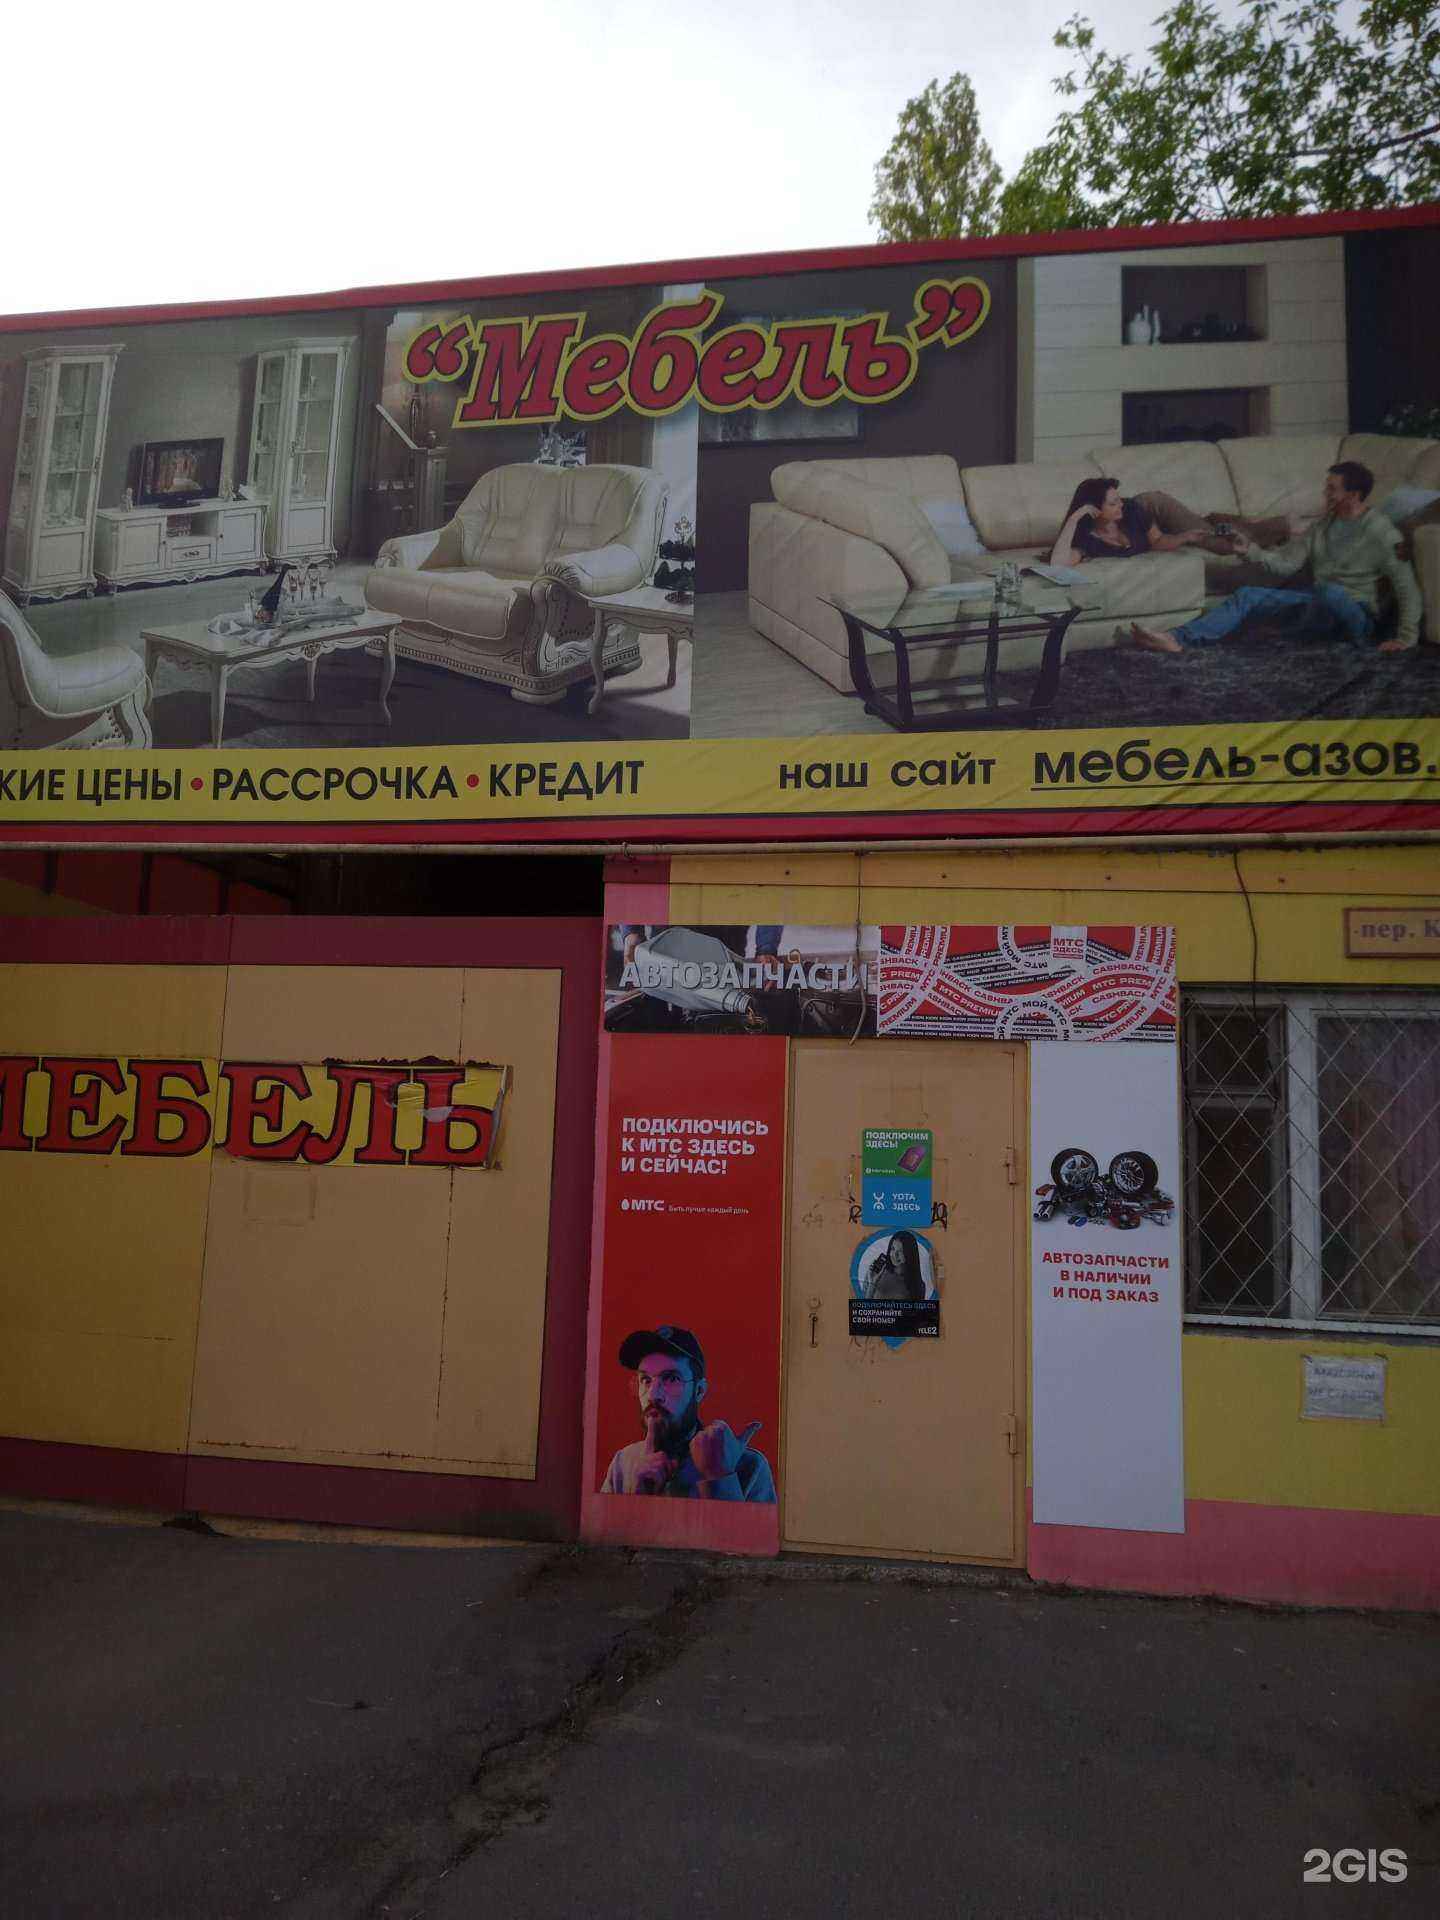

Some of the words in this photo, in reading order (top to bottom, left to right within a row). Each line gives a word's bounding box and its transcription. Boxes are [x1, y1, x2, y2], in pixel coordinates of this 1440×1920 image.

[778, 759, 869, 790] наш
[890, 751, 997, 788] сайт
[76, 768, 182, 806] ЦЕНЫ
[212, 764, 459, 802] РАССРОЧКА
[489, 759, 645, 801] КРЕДИТ
[1360, 923, 1416, 942] пер.
[1053, 938, 1085, 947] МТС
[620, 962, 869, 990] АВТОЗАПЧАСТИ
[622, 1117, 769, 1136] ПОДКЛЮЧИСЬ
[865, 1131, 929, 1141] ПОДКЛЮЧИМ
[621, 1137, 634, 1152] К
[640, 1138, 682, 1154] МТС
[688, 1139, 756, 1157] ЗДЕСЬ
[621, 1157, 634, 1172] И
[640, 1154, 727, 1175] СЕЙЧАС!
[631, 1199, 665, 1212] МТС
[891, 1202, 921, 1212] ЗДЕСЬ
[1042, 1252, 1169, 1268] АВТОЗАПЧАСТИ
[1060, 1270, 1070, 1281] В
[1074, 1271, 1152, 1286] НАЛИЧИИ
[1053, 1286, 1064, 1299] И
[1068, 1287, 1103, 1302] ПОД
[1106, 1289, 1160, 1303] ЗАКАЗ
